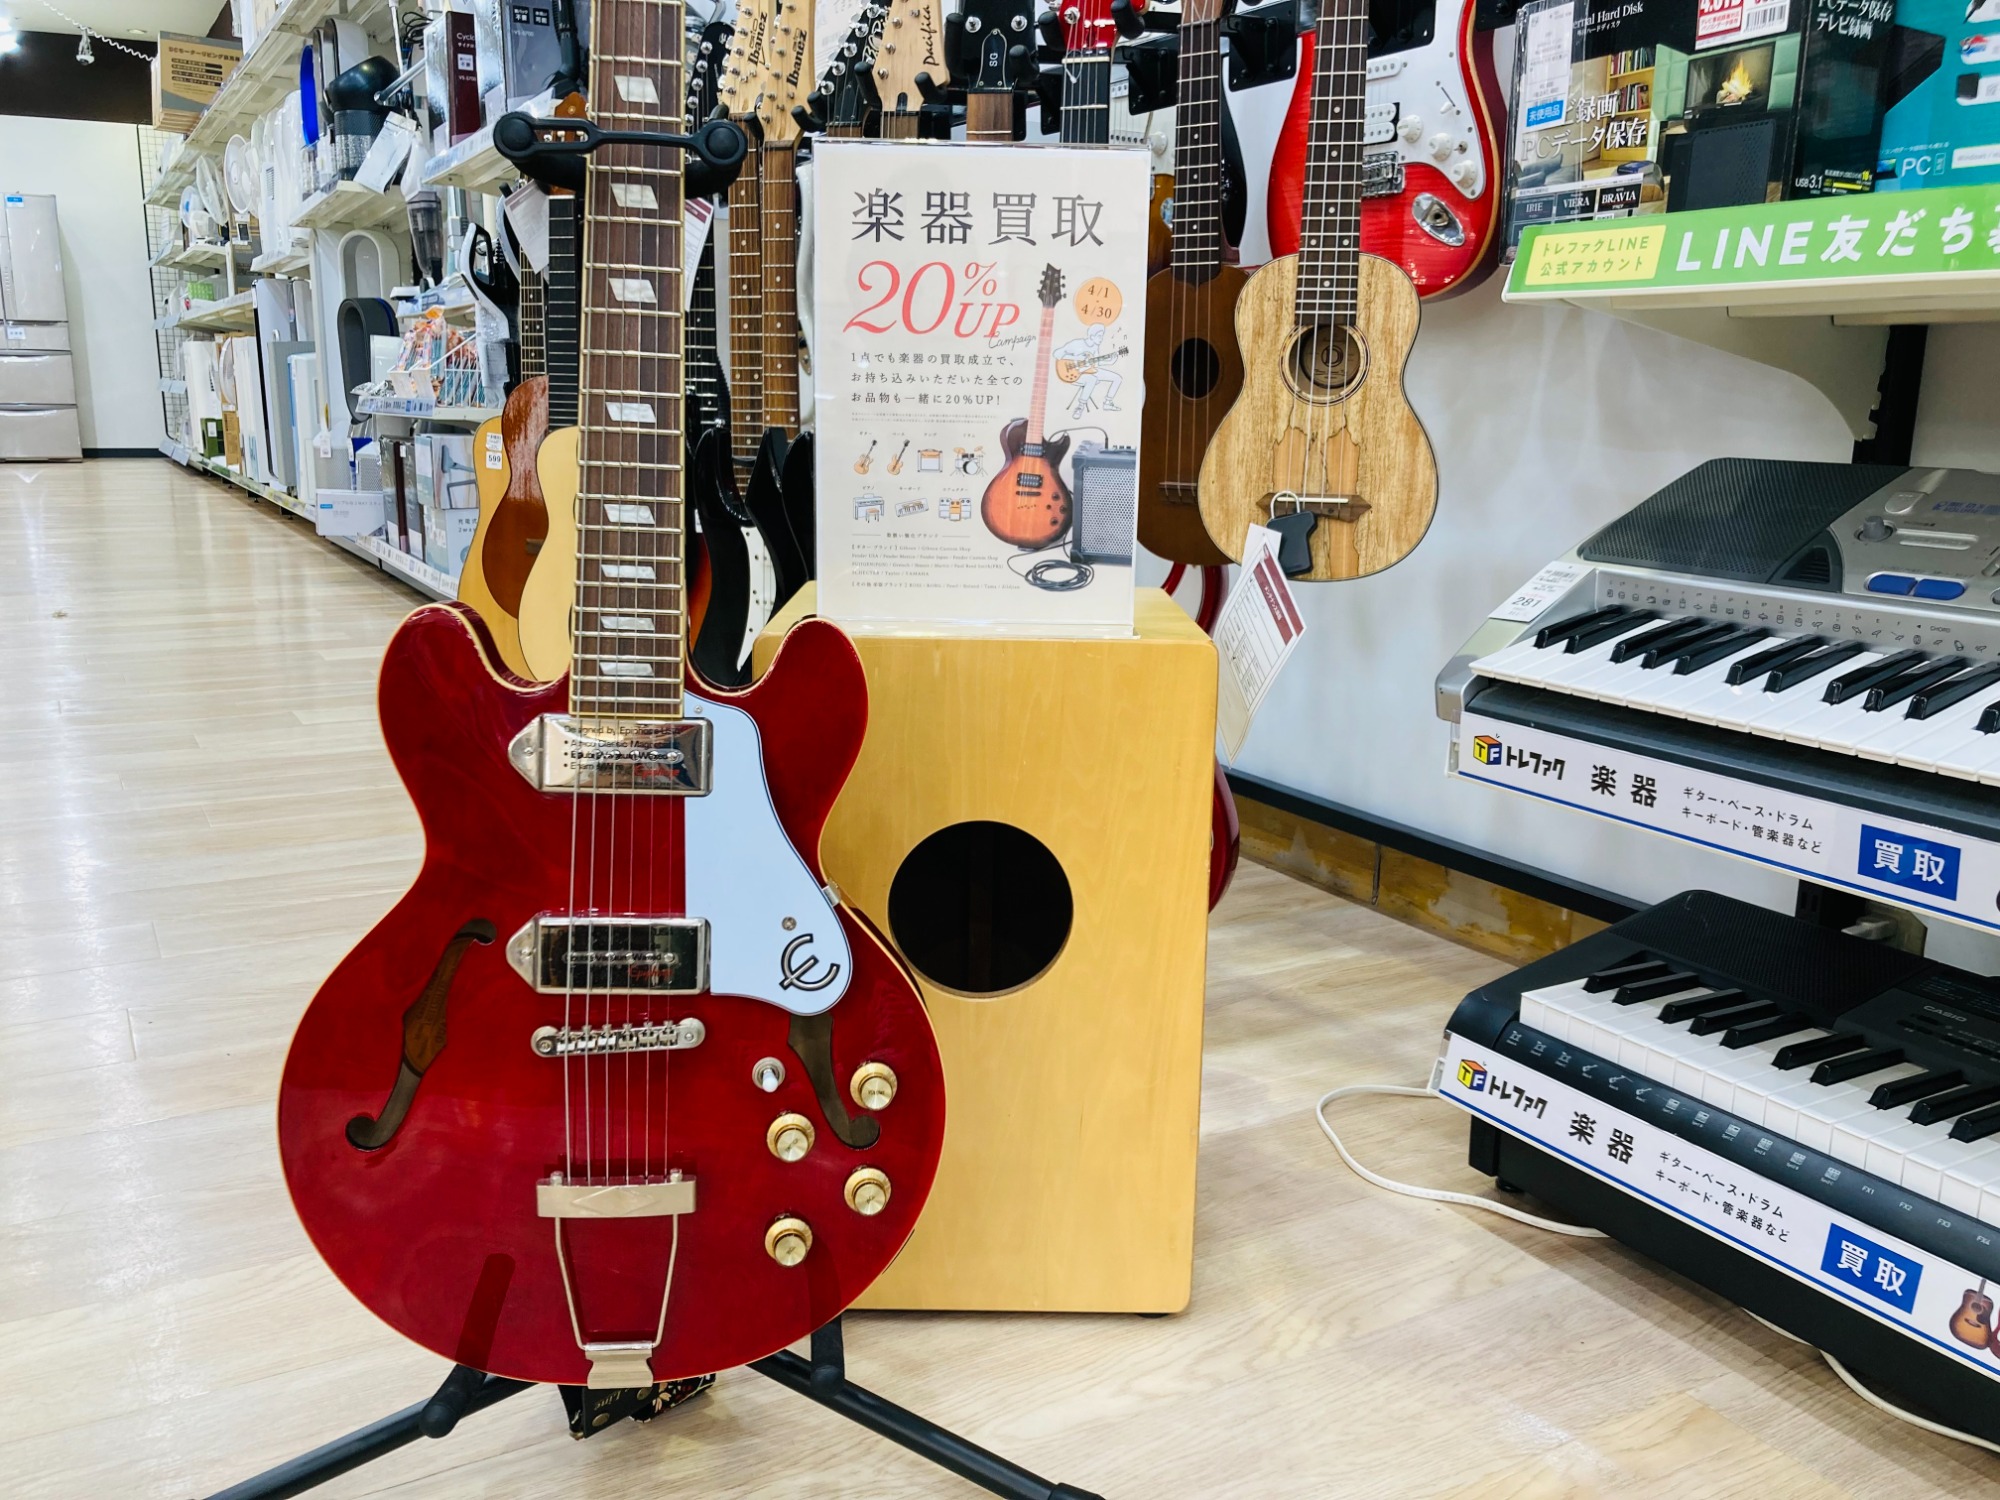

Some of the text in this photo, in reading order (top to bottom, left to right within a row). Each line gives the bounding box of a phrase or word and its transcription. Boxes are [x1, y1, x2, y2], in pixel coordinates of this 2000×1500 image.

[1573, 1, 1644, 29] ernal Hard Disk
[747, 11, 768, 67] Ibanez
[919, 4, 940, 68] Pacifica
[785, 29, 808, 90] Ibanez
[989, 52, 999, 67] SG
[1528, 104, 1561, 122] 未使用品
[1521, 118, 1648, 162] PCデータ保存
[1901, 155, 1932, 178] PC
[1563, 196, 1590, 209] VIERA
[1601, 190, 1637, 205] BRAVIA
[851, 187, 1105, 248] 楽器買取
[1541, 235, 1650, 258] トレファクLINE
[1539, 257, 1644, 278] 公式アカウント
[1087, 284, 1110, 299] 4/1
[953, 302, 1021, 339] UP
[1080, 304, 1113, 320] 4/30
[988, 330, 1037, 350] Campaign
[851, 351, 1016, 367] 1点でも楽器の買取成立で、
[851, 371, 1023, 386] お持ち込みいただいた全ての
[488, 454, 501, 464] 599
[1511, 596, 1543, 608] 281
[1506, 745, 1566, 781] トレファク
[1590, 763, 1658, 809] 楽器
[1682, 786, 1814, 832] ギター・ベース・ドラム
[1681, 806, 1822, 855] キーボード・管楽器など
[1873, 838, 1946, 886] 買取
[1923, 1005, 1968, 1023] CASIO
[1488, 1075, 1549, 1120] トレファク
[1568, 1110, 1635, 1165] 楽器
[1658, 1150, 1785, 1220] ギター・ベース・ドラム
[1861, 1185, 1875, 1195] FX1
[1655, 1168, 1792, 1244] キーボード・管楽器など
[1898, 1201, 1913, 1212] FX2
[1936, 1218, 1952, 1228] FX3
[1976, 1235, 1991, 1246] FX4
[1837, 1239, 1908, 1298] 買取
